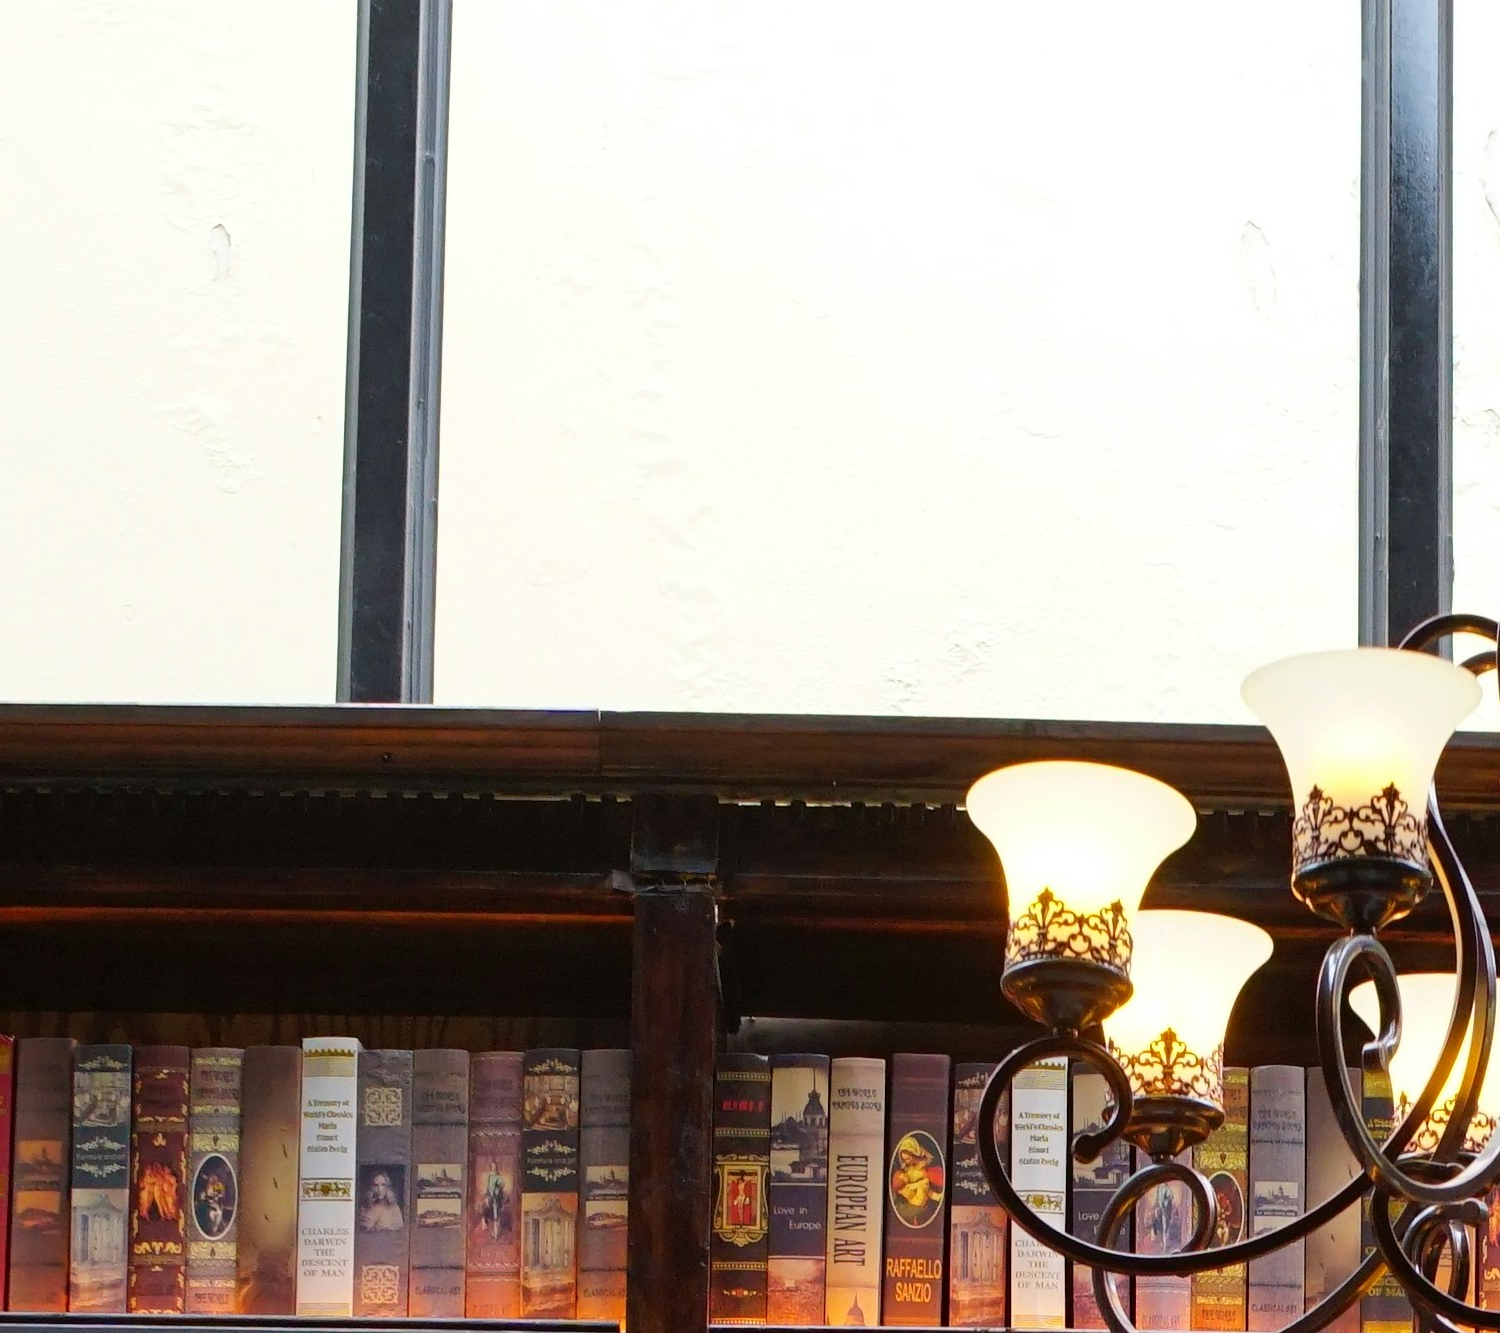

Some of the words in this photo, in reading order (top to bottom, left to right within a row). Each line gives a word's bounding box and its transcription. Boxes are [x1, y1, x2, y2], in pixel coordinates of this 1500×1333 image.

[835, 1154, 868, 1232] EUROPEAN
[773, 1206, 795, 1215] Love
[788, 1221, 822, 1231] Europe
[833, 1237, 866, 1266] ART
[1017, 1250, 1059, 1259] DARWIN
[886, 1259, 941, 1279] RAFFAELLO
[1015, 1271, 1061, 1279] DESCENT
[895, 1282, 931, 1303] SANZIO
